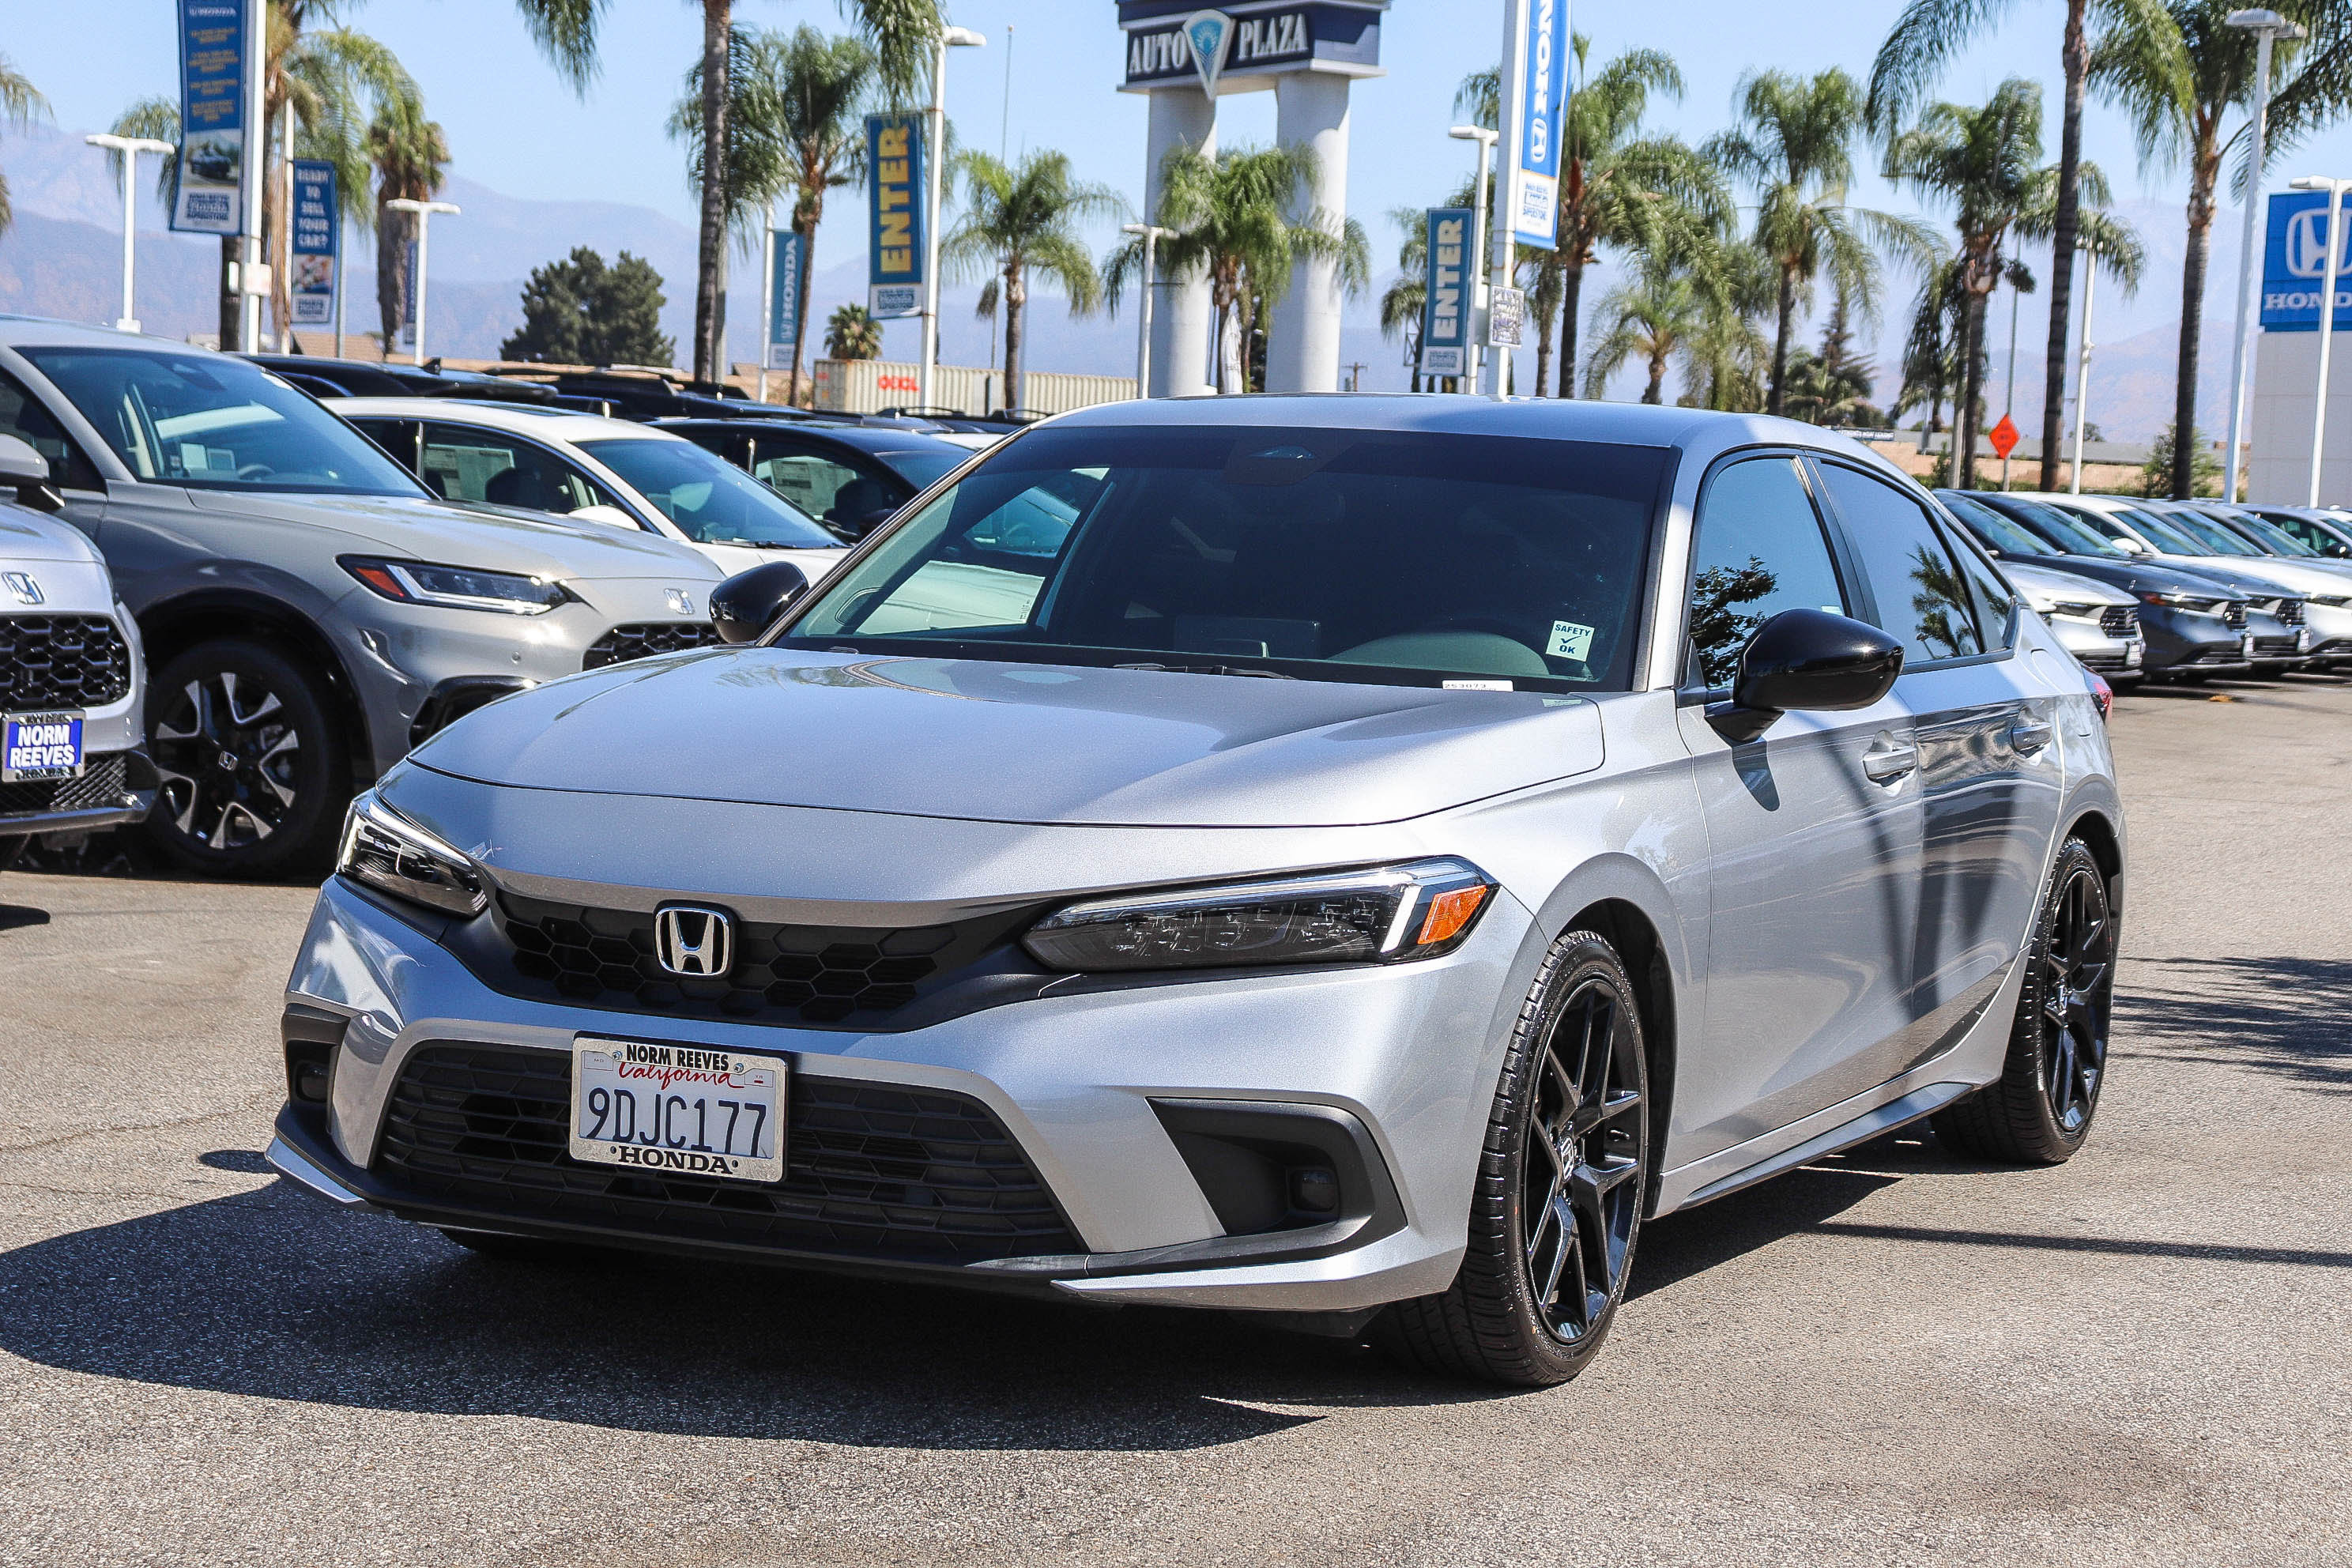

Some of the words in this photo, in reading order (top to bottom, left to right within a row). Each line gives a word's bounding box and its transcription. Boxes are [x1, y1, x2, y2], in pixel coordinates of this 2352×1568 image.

[1129, 30, 1189, 75] AUTO
[1238, 13, 1309, 61] PLAZA
[878, 124, 912, 273] ENTER
[1433, 218, 1463, 339] ENTER
[1555, 624, 1591, 636] SAFETY
[1559, 645, 1576, 654] OK
[17, 724, 70, 747] NORM
[9, 744, 75, 768] REEVES
[626, 1044, 671, 1065] NORM
[677, 1050, 729, 1072] REEVES
[618, 1062, 744, 1090] California
[586, 1087, 767, 1158] 9DJC177
[618, 1146, 733, 1175] HONDA
